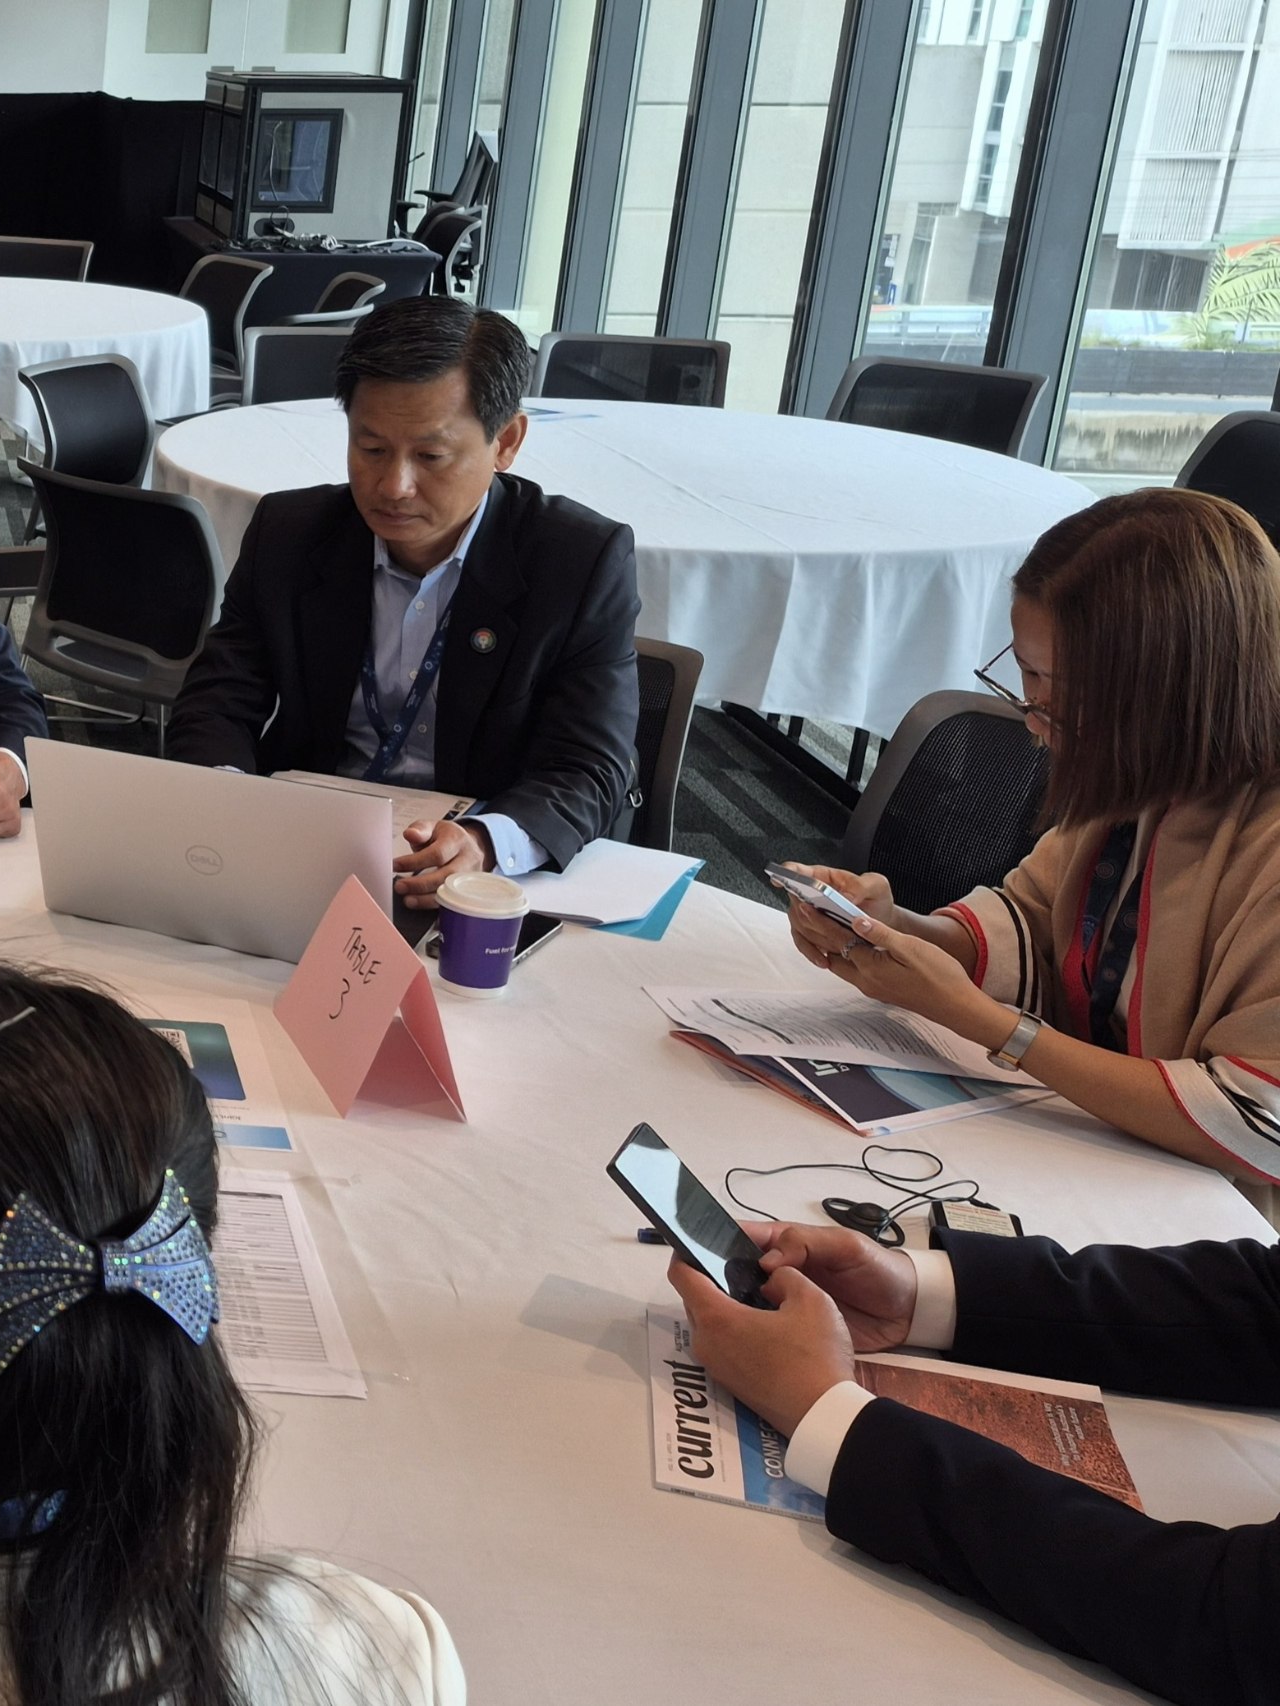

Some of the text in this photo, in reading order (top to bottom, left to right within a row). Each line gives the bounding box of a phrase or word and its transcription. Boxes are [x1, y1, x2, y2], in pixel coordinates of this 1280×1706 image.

[342, 927, 382, 984] TABLE
[328, 978, 351, 1020] 3
[673, 1321, 682, 1352] AUSTRALIAN
[663, 1359, 715, 1479] current
[759, 1419, 785, 1479] CONNEC
